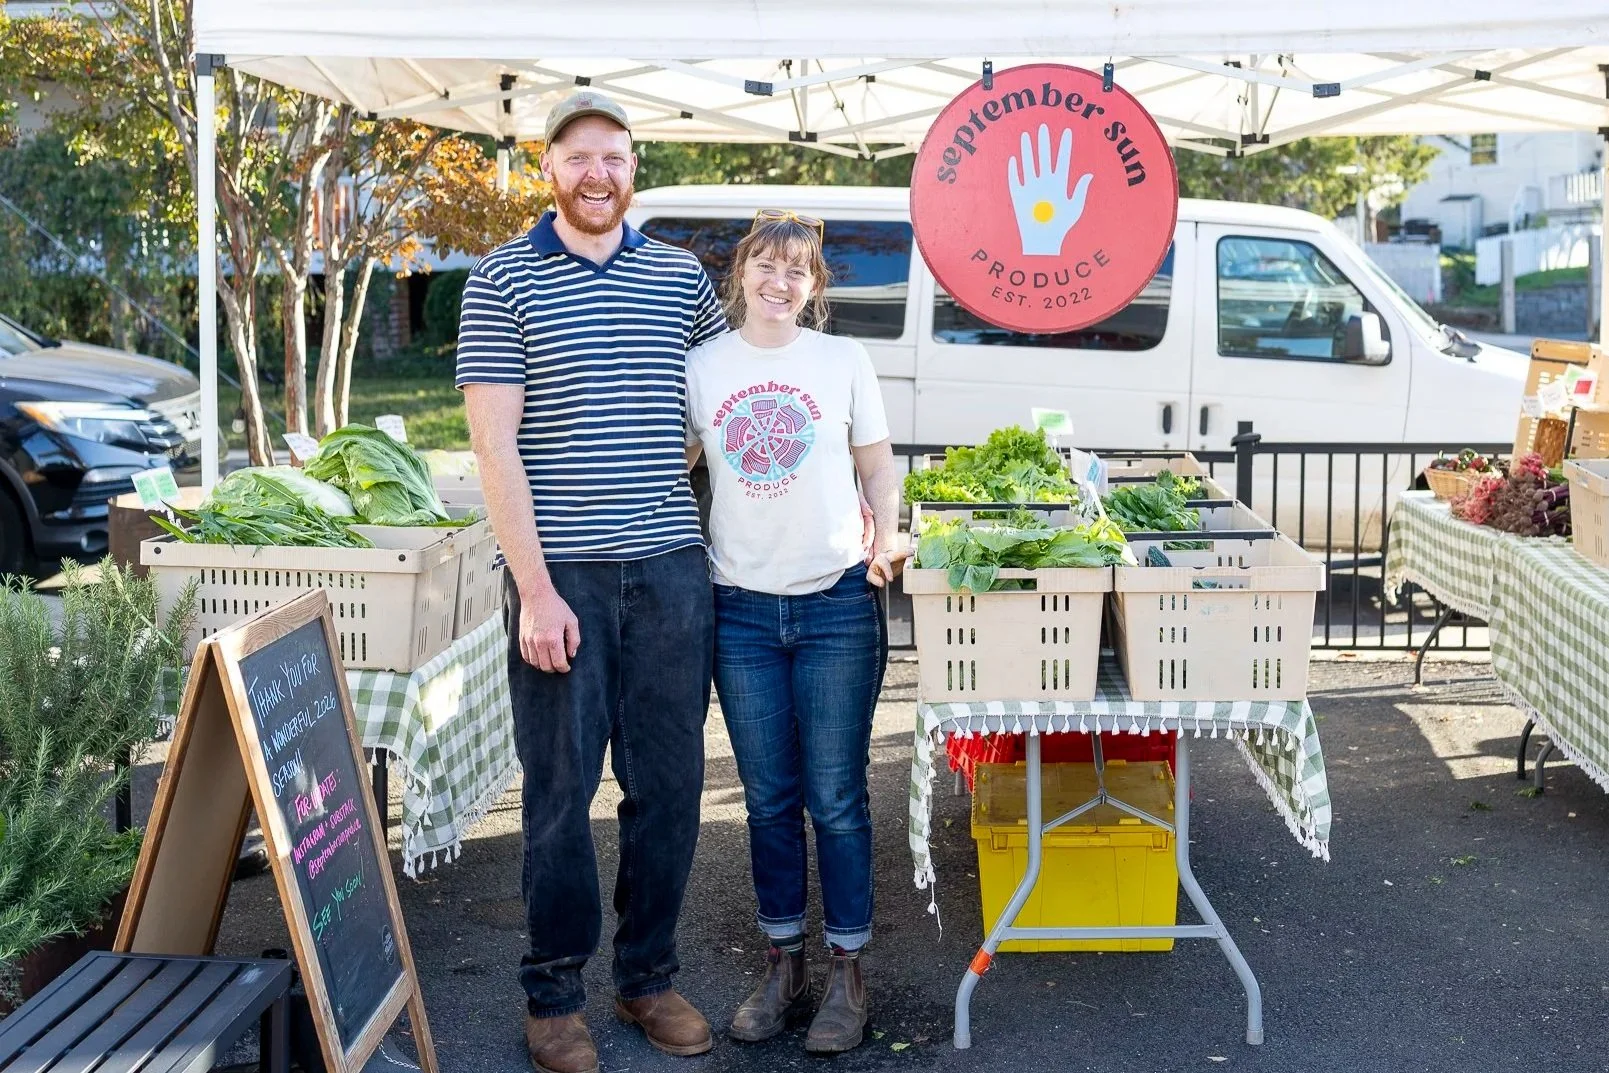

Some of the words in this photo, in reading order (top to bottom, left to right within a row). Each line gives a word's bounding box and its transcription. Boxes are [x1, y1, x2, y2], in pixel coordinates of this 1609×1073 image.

[936, 82, 1105, 185] september
[1103, 120, 1147, 187] sun
[971, 248, 1111, 289] PRODUCE
[991, 286, 1032, 308] EST.
[1044, 287, 1092, 309] 2022
[713, 380, 801, 428] september
[799, 393, 822, 421] sun
[737, 472, 798, 491] PRODUCE
[745, 490, 764, 500] EST.
[768, 488, 789, 499] 2022
[248, 676, 285, 728] THANK
[280, 661, 302, 699] YOU
[262, 740, 274, 761] A
[271, 707, 317, 753] WONDERFUL
